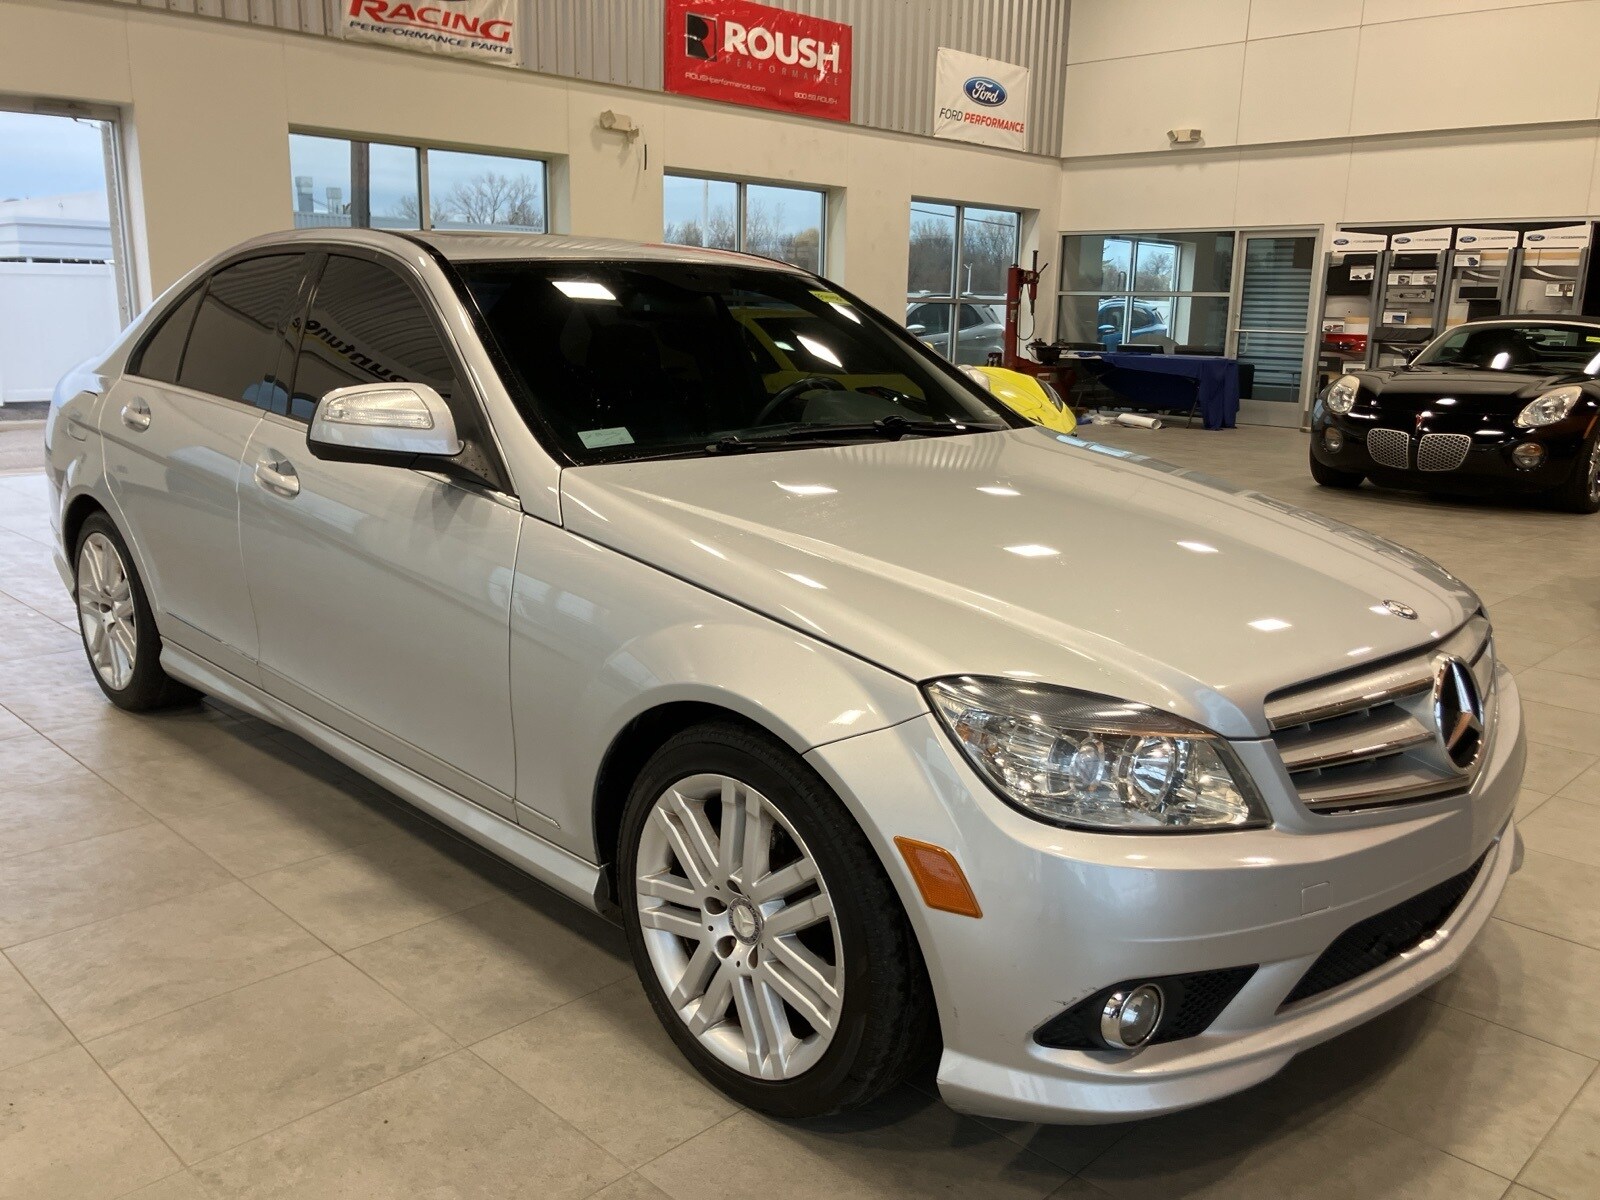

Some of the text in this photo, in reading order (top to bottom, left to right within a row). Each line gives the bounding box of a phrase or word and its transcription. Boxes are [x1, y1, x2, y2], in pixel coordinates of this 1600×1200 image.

[349, 0, 513, 43] RACING
[350, 20, 513, 55] PERFORMANCE PARTS
[724, 21, 840, 74] ROUSH
[725, 56, 839, 86] PERFORMANCE
[972, 80, 999, 103] Ford
[939, 107, 1024, 133] FORD PERFORMANCE
